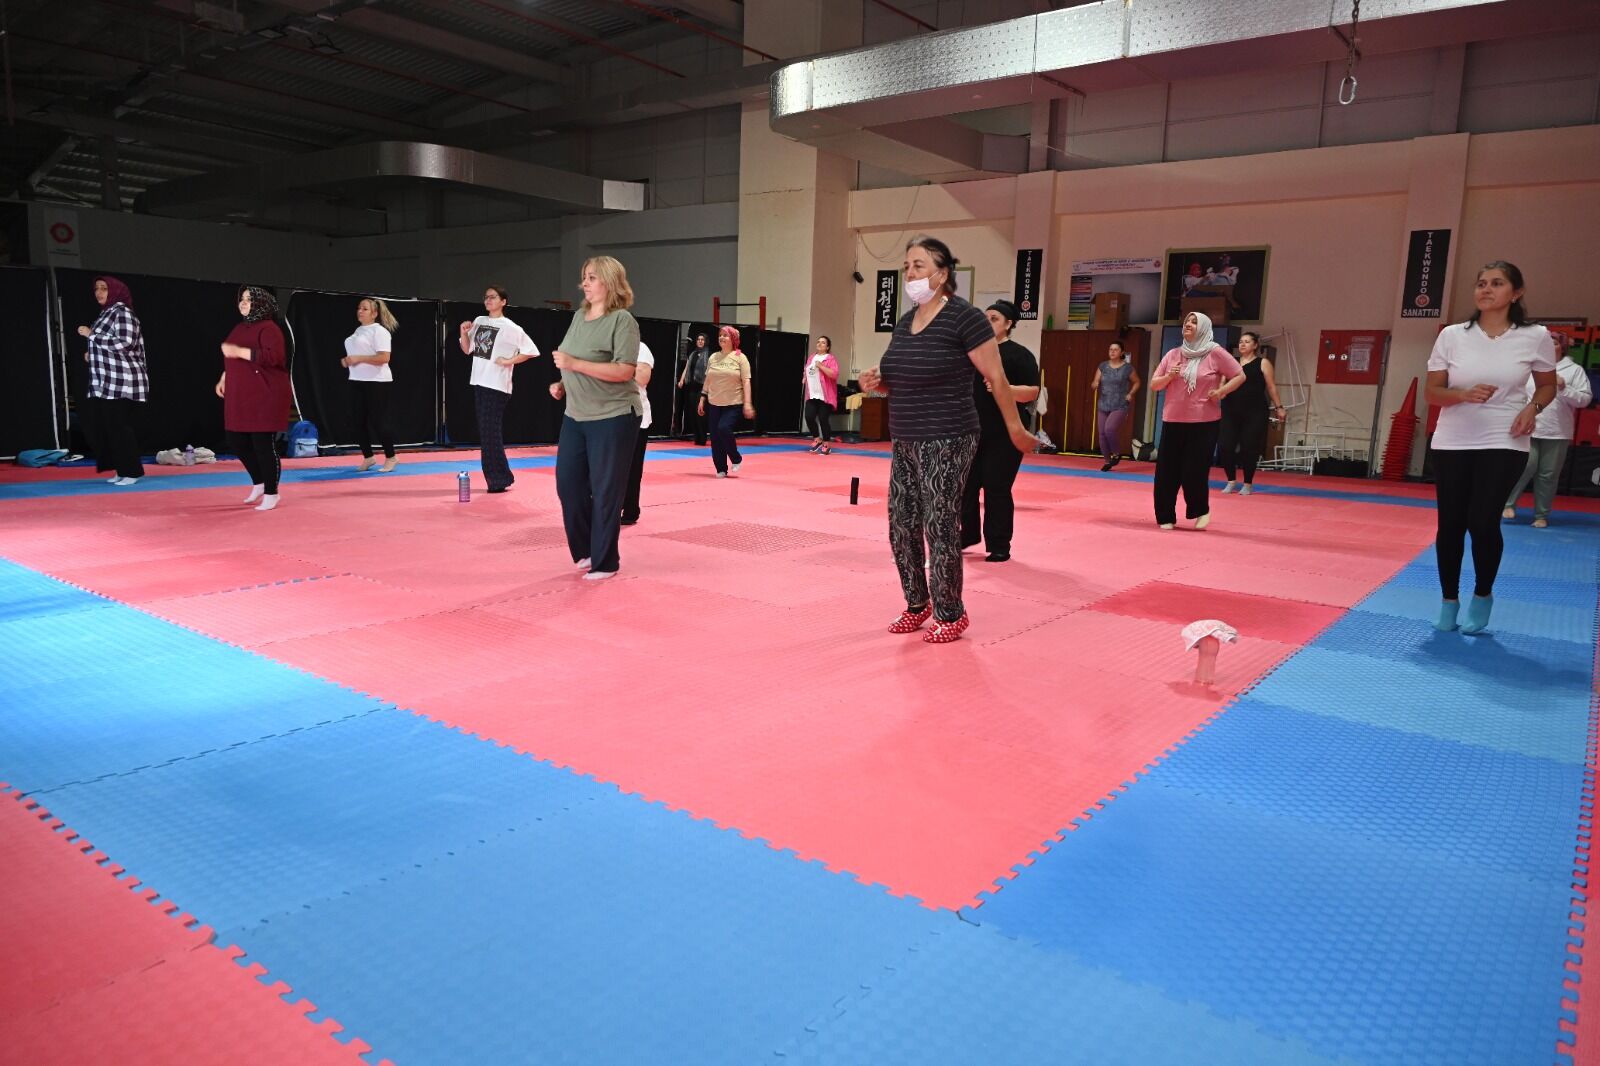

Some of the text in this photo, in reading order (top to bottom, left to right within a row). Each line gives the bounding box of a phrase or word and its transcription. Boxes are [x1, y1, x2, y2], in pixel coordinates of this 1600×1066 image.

[1420, 232, 1434, 294] TAEKWONDO
[878, 275, 894, 328] 태권도
[1402, 308, 1440, 317] SANATTIR
